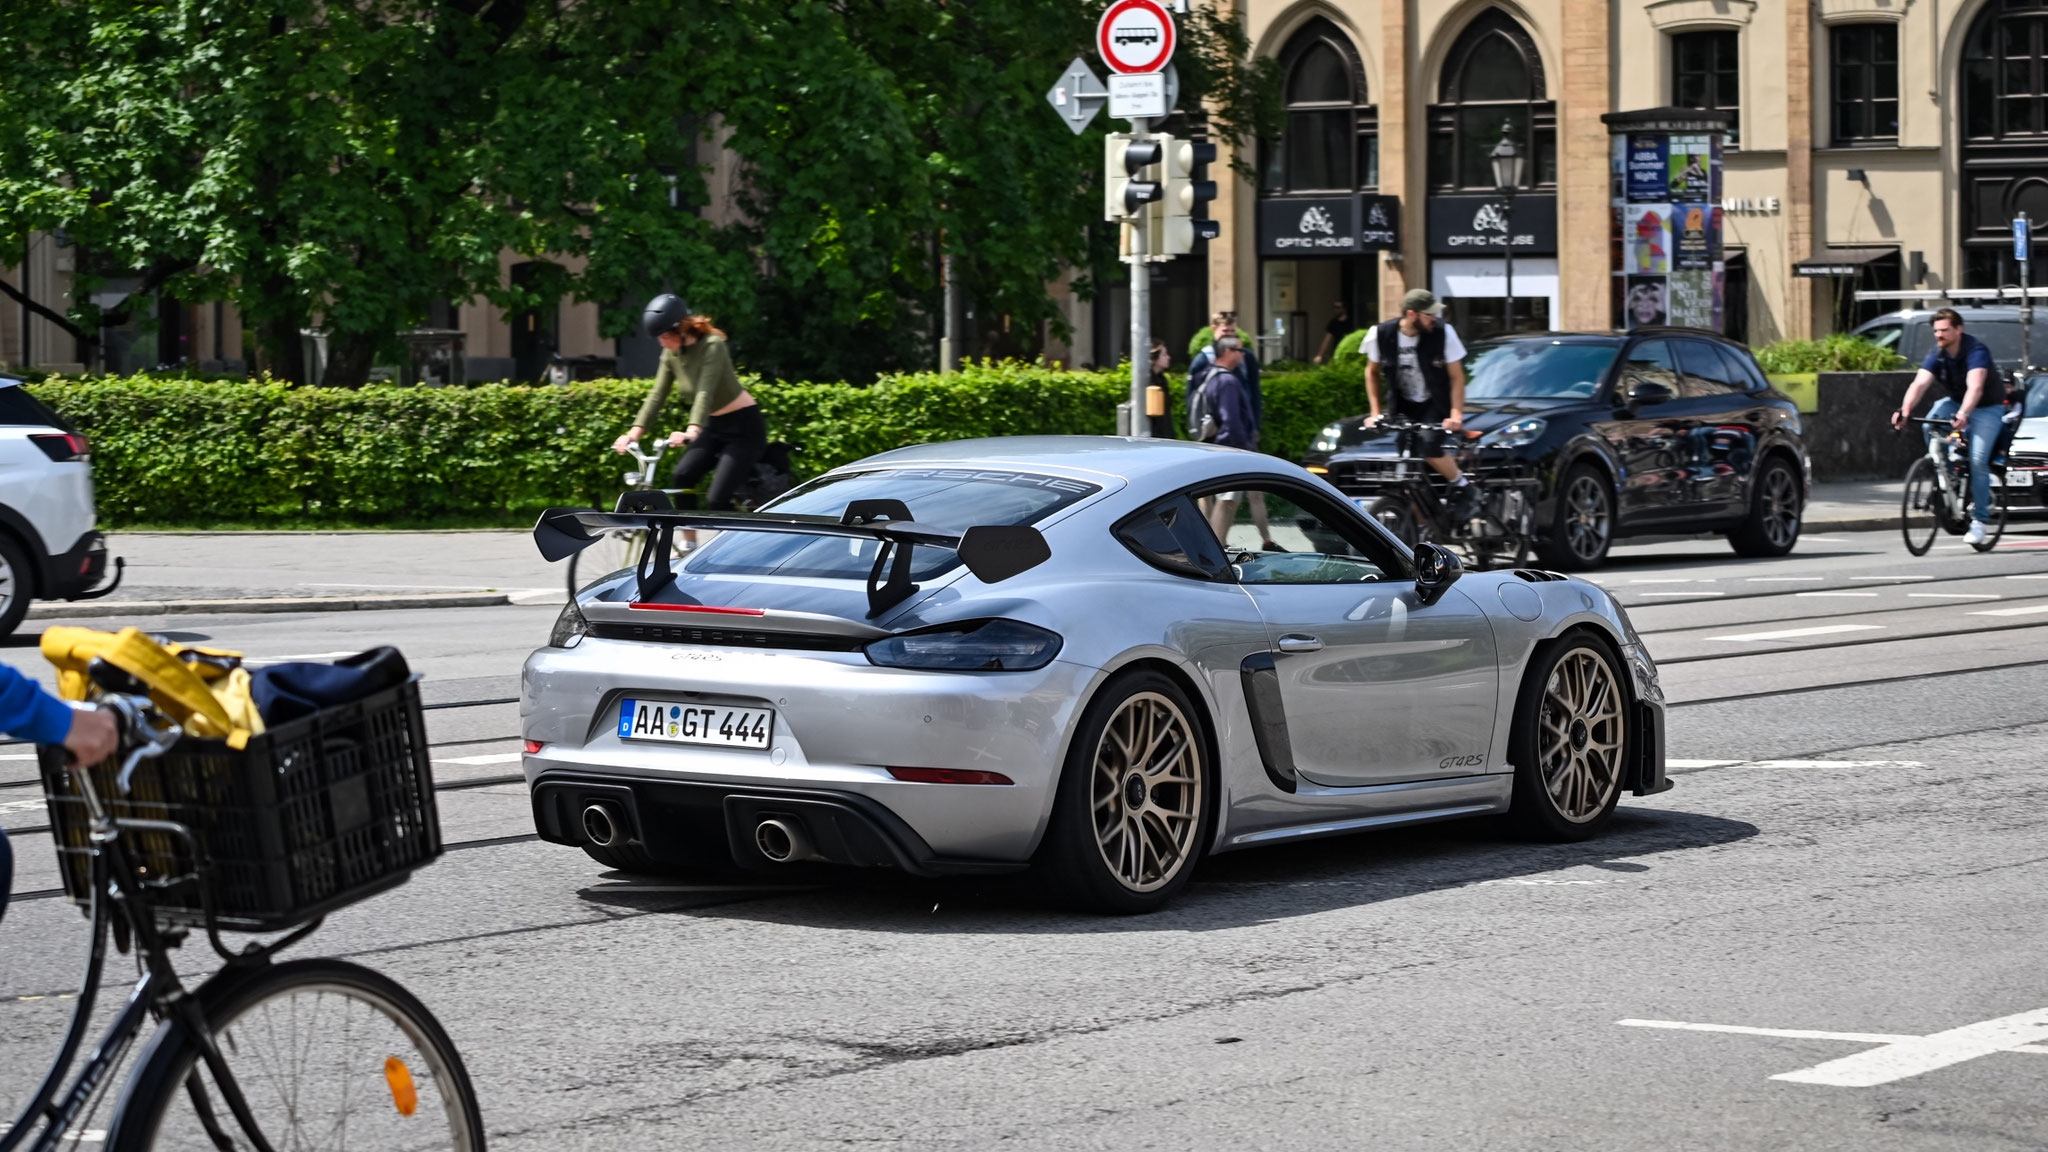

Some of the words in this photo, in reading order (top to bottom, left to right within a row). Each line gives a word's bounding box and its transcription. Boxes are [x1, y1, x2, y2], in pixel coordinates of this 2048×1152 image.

[1633, 152, 1658, 161] ABBA
[1629, 161, 1664, 170] Summer
[1634, 171, 1658, 182] Night
[1275, 237, 1313, 248] OPTIC
[1364, 231, 1394, 243] OPTIC
[1448, 235, 1487, 246] OPTIC
[633, 627, 767, 643] PORSCHE
[622, 722, 629, 731] D
[634, 705, 664, 735] AA
[682, 708, 716, 738] GT
[719, 711, 766, 743] 444
